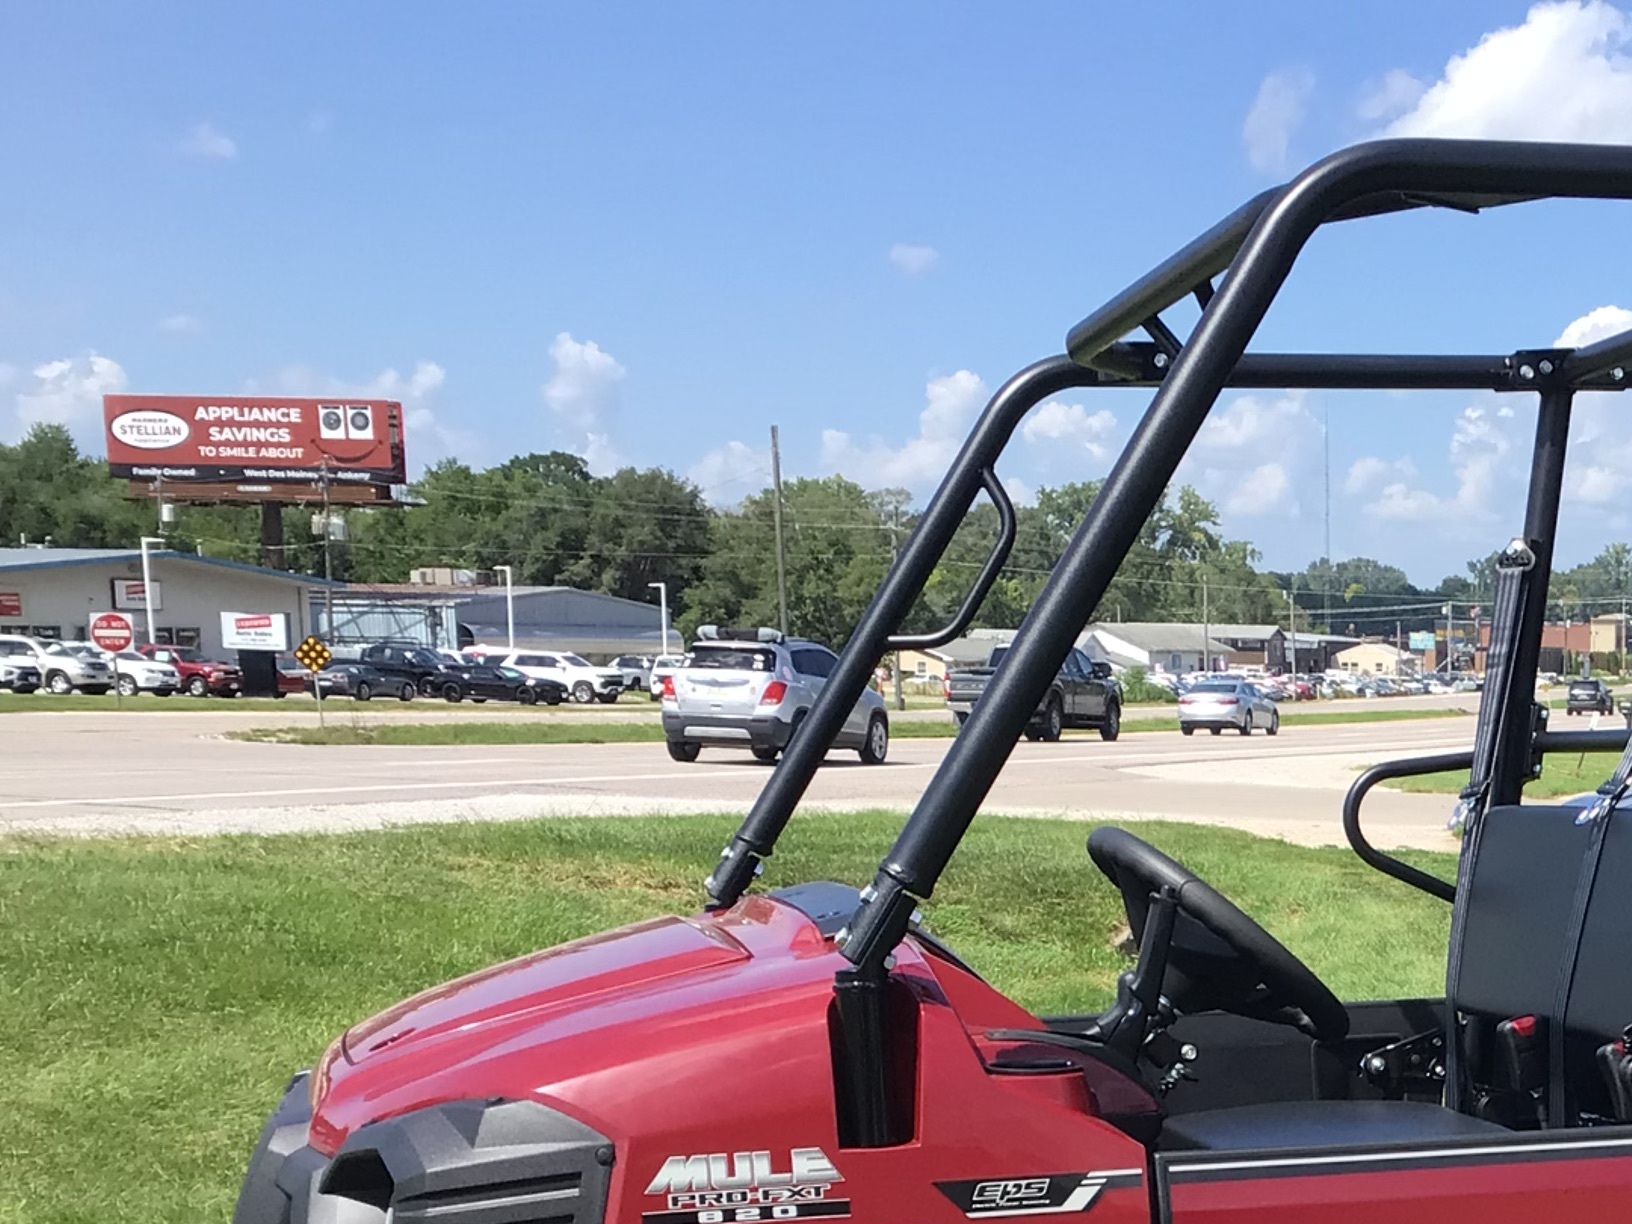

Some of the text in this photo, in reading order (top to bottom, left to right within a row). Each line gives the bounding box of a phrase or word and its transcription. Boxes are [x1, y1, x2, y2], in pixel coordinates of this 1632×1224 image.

[194, 406, 303, 422] APPLIANCE
[119, 425, 182, 436] STELLIAN
[208, 426, 291, 442] SAVINGS
[198, 446, 304, 459] TO SMILE ABOUT
[95, 620, 126, 628] DO NOT
[644, 1147, 846, 1195] MULE
[972, 1178, 1050, 1205] EPS
